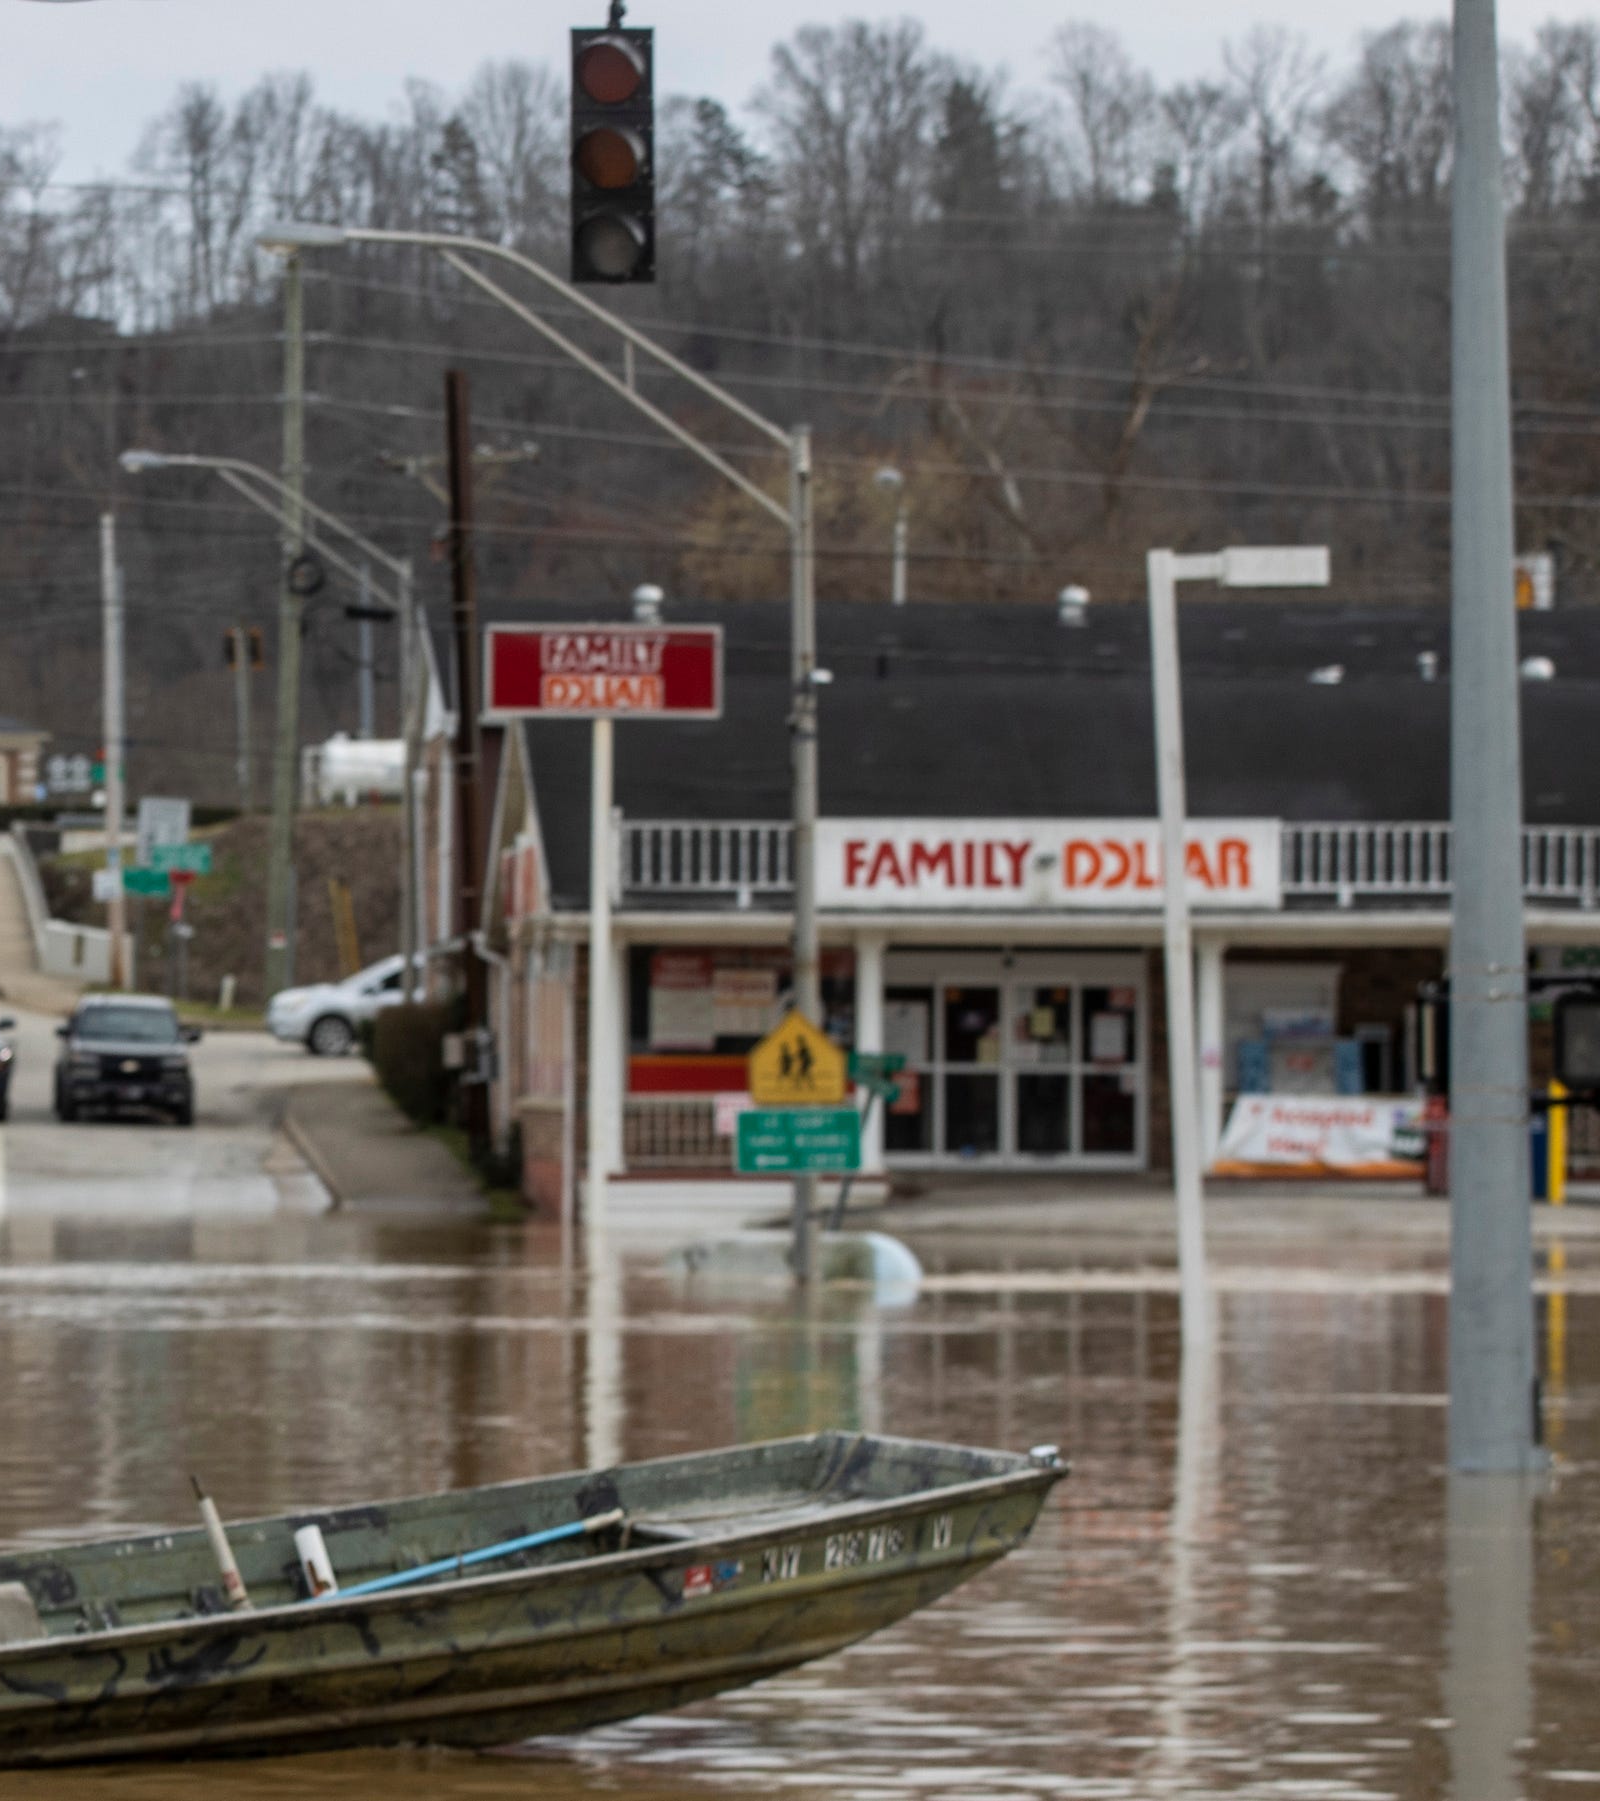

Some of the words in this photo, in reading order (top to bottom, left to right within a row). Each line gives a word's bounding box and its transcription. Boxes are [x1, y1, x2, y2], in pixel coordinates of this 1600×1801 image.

[543, 635, 665, 673] FAMILY
[544, 674, 661, 708] DOLLAR
[843, 840, 1032, 888] FAMILY
[1063, 838, 1251, 890] DOLAR
